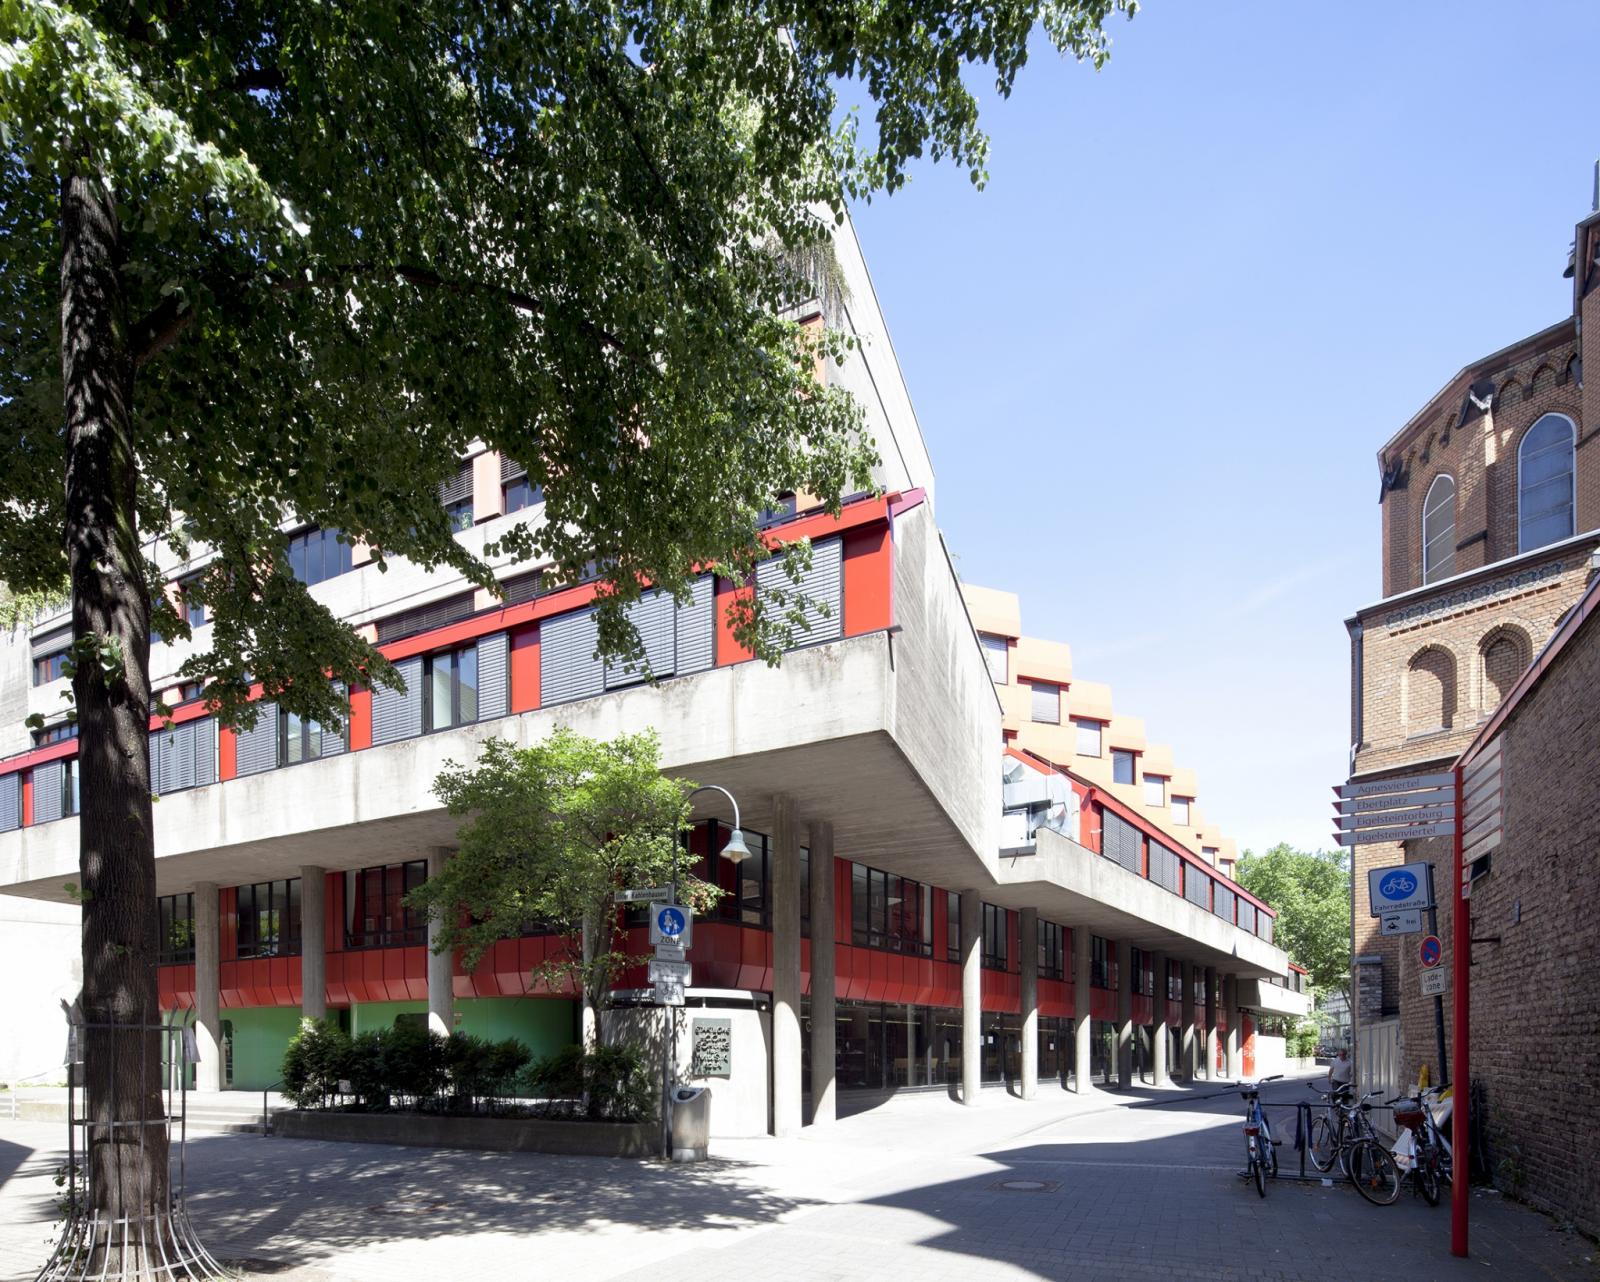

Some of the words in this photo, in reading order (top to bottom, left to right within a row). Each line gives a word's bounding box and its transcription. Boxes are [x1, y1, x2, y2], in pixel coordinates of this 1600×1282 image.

[1357, 778, 1420, 794] Agnesviertel
[1357, 798, 1408, 810] Ebertplatz
[1357, 810, 1443, 827] Eigelsteintorburg
[1357, 826, 1436, 842] Eigelsteinviertel
[1374, 900, 1426, 911] Fahrradstraße
[660, 935, 681, 944] ZONE
